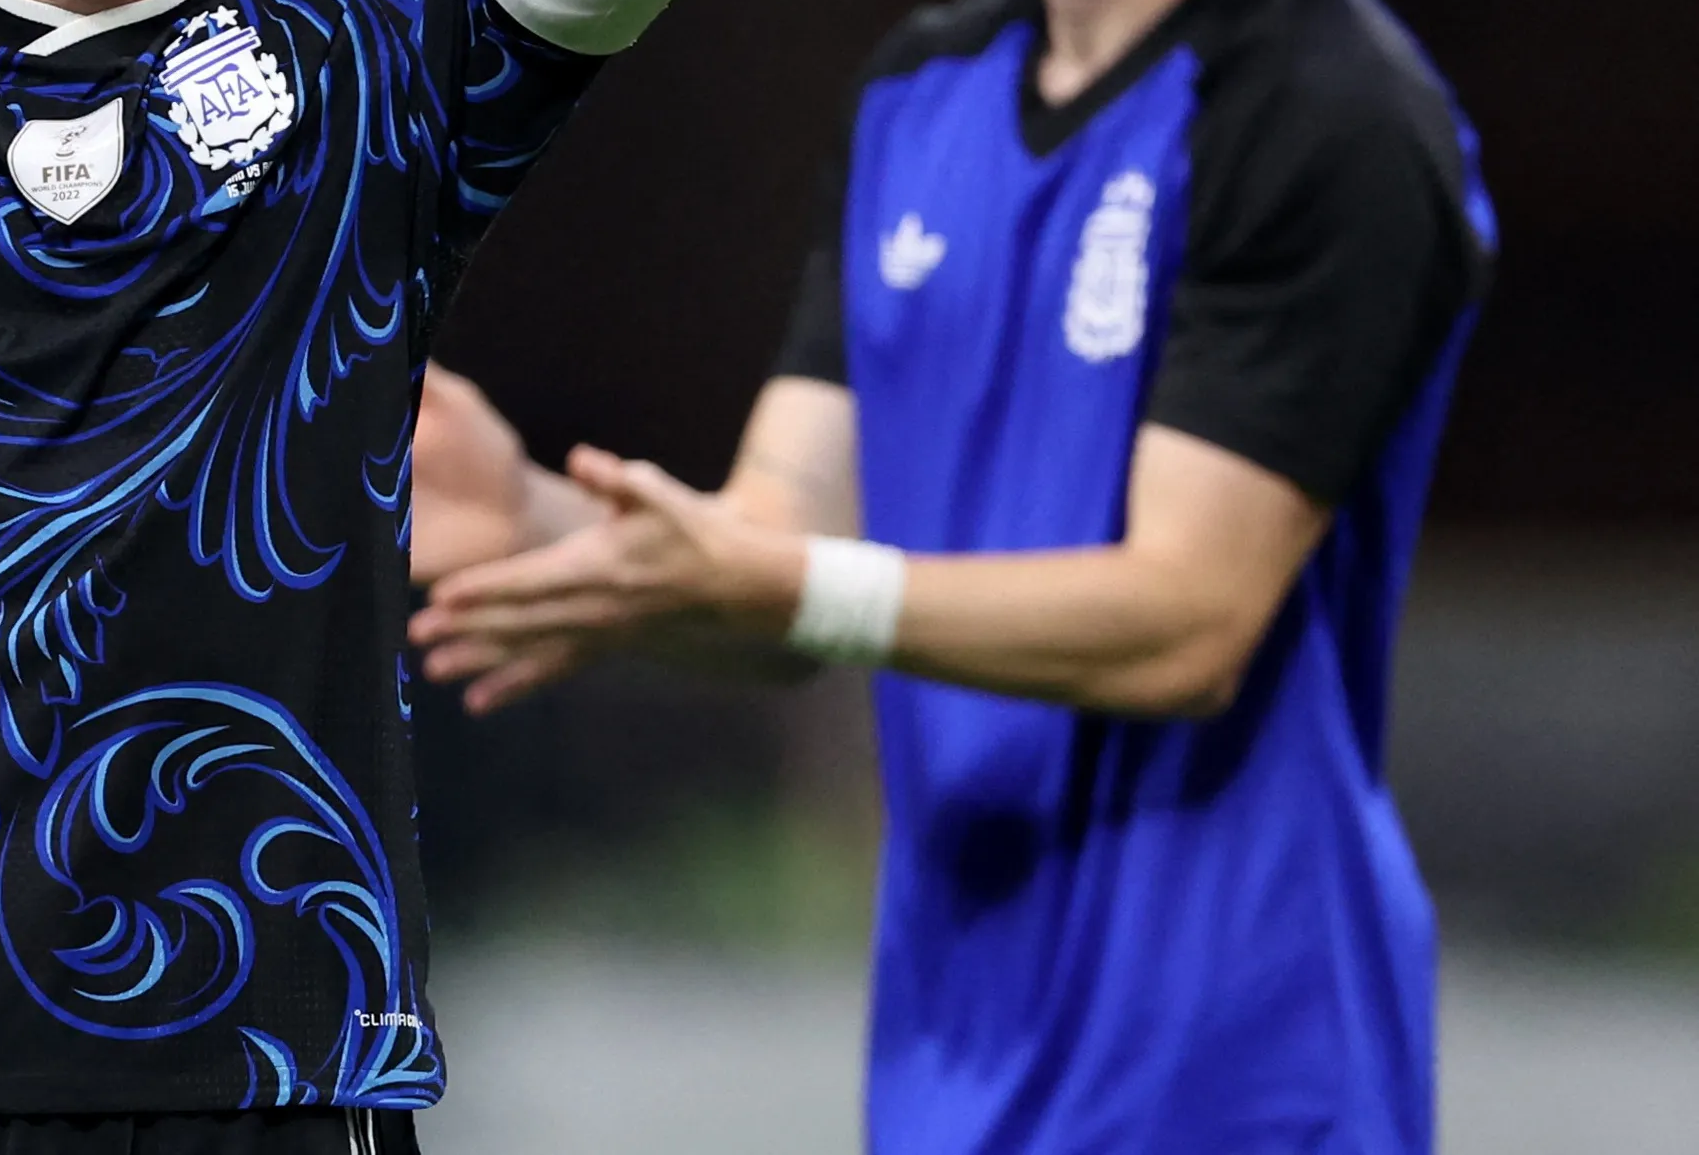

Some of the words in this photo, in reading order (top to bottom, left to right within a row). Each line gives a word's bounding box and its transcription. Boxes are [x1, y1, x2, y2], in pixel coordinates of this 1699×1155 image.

[194, 63, 263, 126] AFA
[42, 163, 91, 184] FIFA
[31, 184, 57, 193] WORLD
[58, 180, 104, 190] CHAMPIONS
[52, 190, 80, 202] 2022
